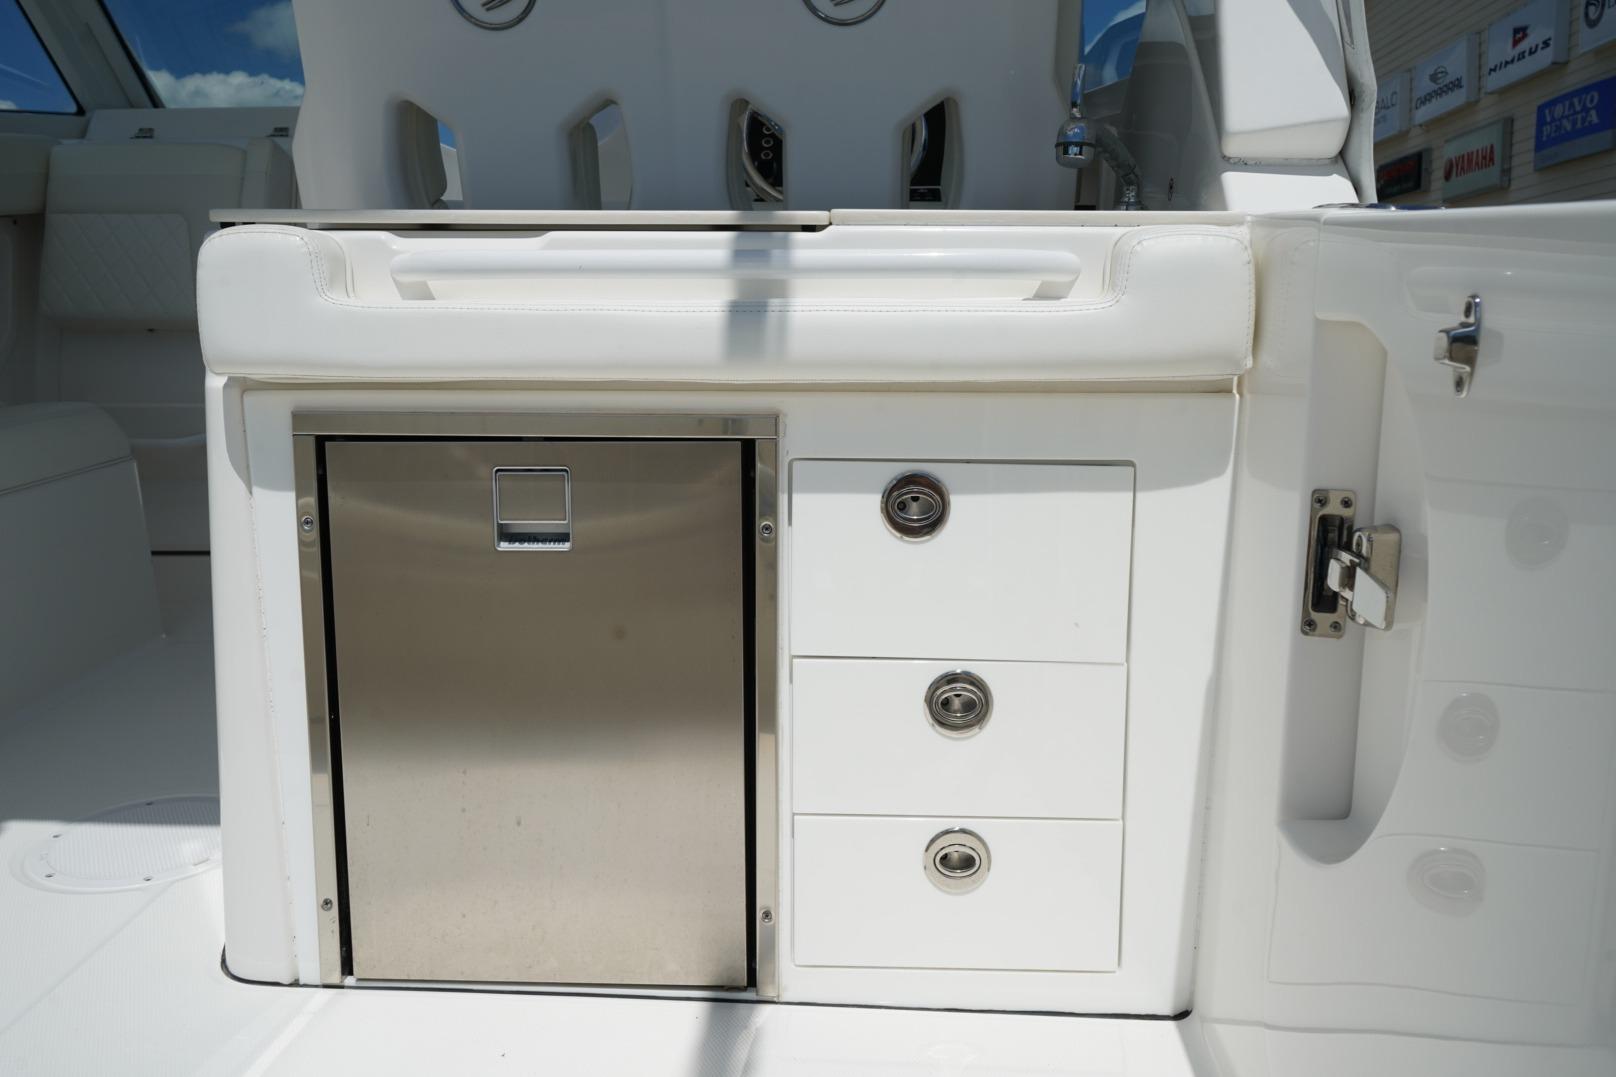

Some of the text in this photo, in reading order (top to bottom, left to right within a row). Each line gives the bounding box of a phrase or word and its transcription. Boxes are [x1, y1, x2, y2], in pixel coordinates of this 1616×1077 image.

[1488, 36, 1552, 76] NIMBUS
[1544, 91, 1599, 123] VOLVO
[1541, 109, 1600, 142] PENTA
[1454, 143, 1495, 178] YAMAHA
